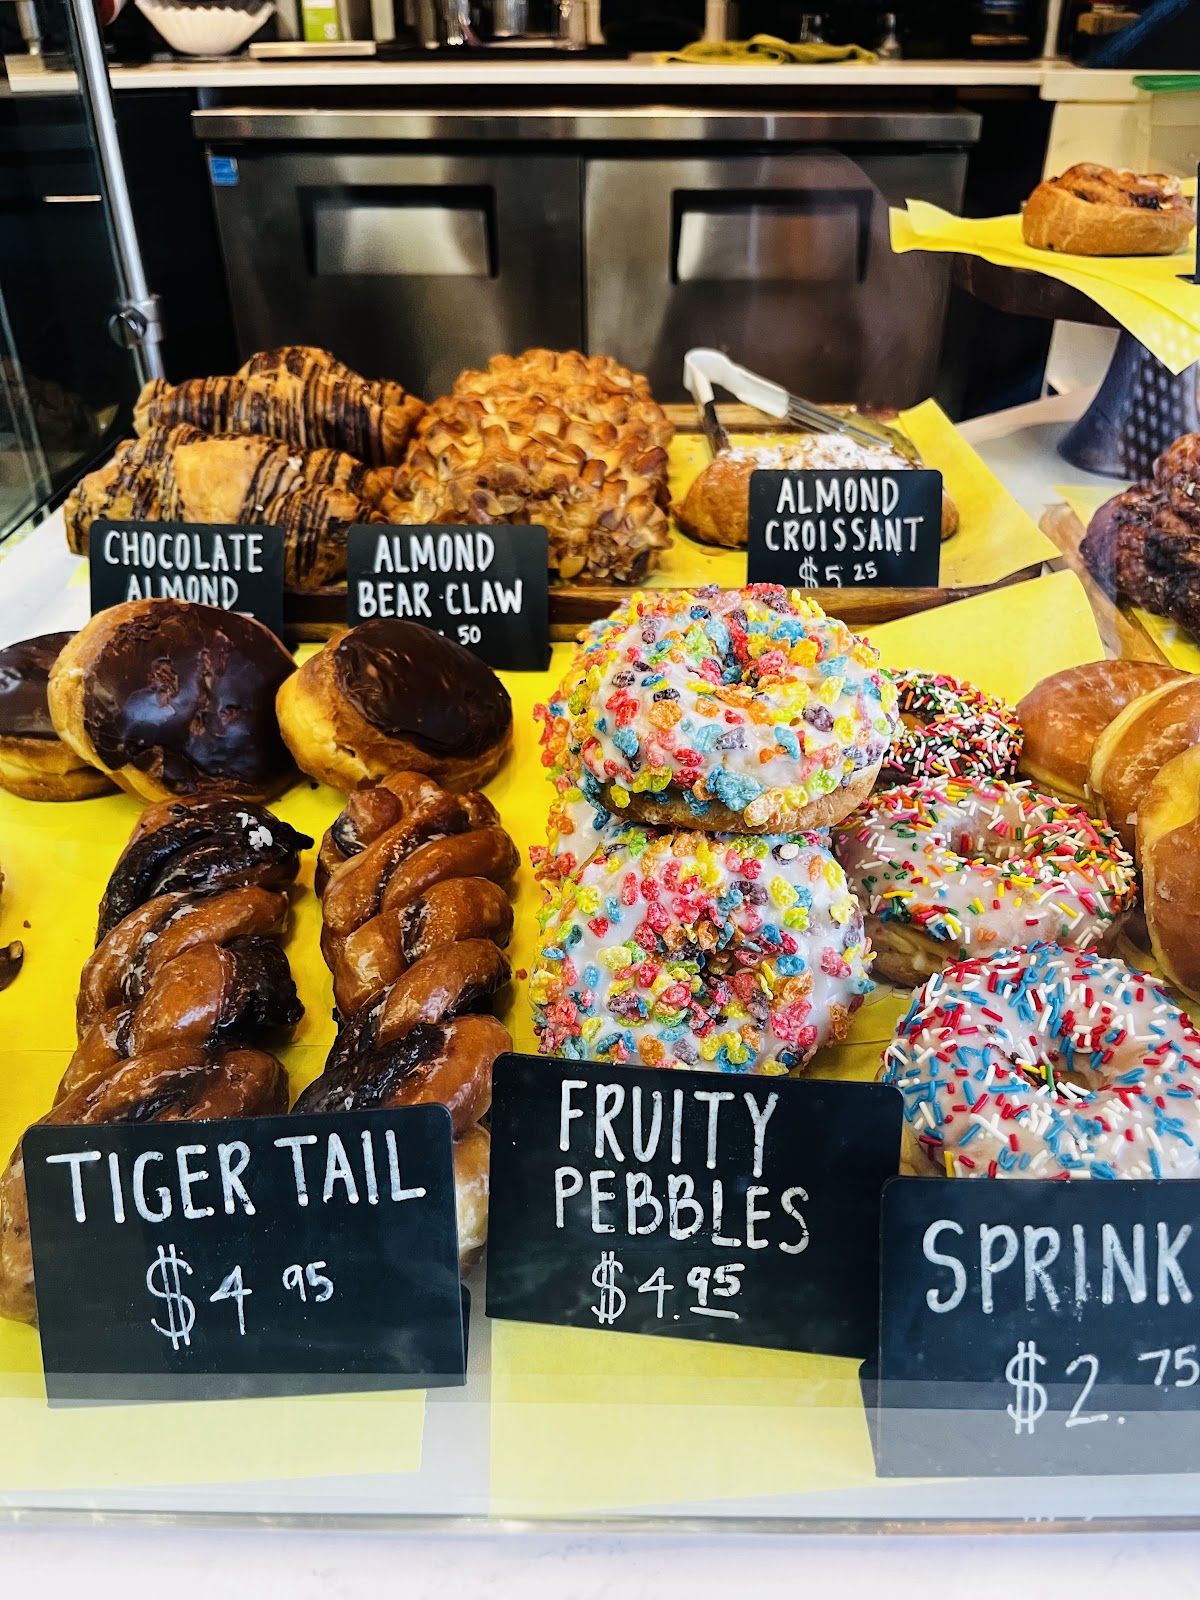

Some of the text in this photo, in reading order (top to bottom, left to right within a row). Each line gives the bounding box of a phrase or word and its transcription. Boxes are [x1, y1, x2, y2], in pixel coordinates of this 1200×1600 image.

[776, 476, 900, 516] ALMOND
[104, 529, 264, 573] CHOCOLATE
[373, 531, 495, 574] ALMOND
[765, 516, 925, 552] CROISSANT
[357, 577, 523, 618] BEAR CLAW
[559, 1079, 779, 1178] FRUITY
[46, 1129, 427, 1224] TIGER TAIL
[554, 1166, 810, 1255] PEBBLES
[922, 1219, 1193, 1316] SPRINK
